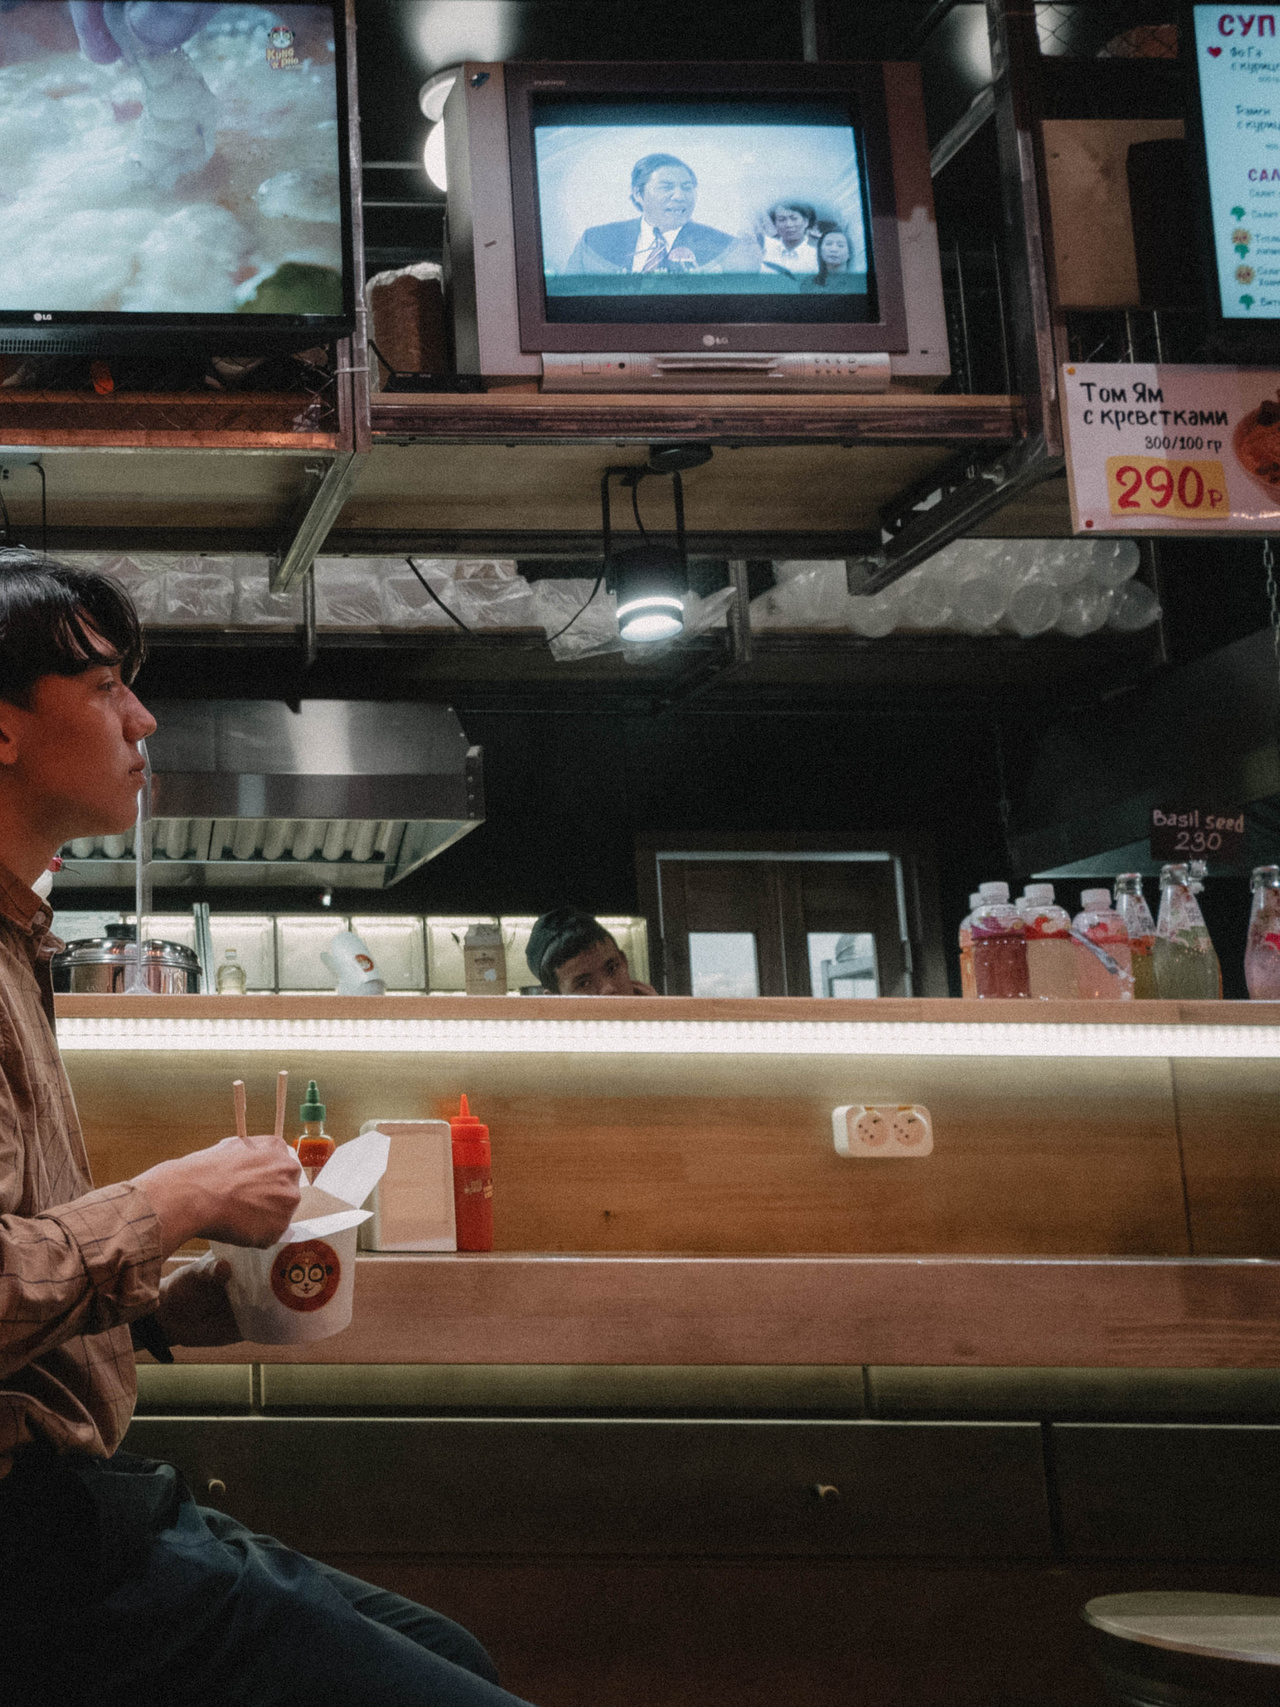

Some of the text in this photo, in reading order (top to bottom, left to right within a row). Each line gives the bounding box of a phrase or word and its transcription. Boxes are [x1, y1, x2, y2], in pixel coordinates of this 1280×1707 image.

[1080, 382, 1164, 403] Том Ям
[1083, 409, 1229, 431] с креветками
[1144, 436, 1223, 454] 300/100 гр
[1152, 809, 1245, 834] Basil seed
[1174, 831, 1223, 853] 230
